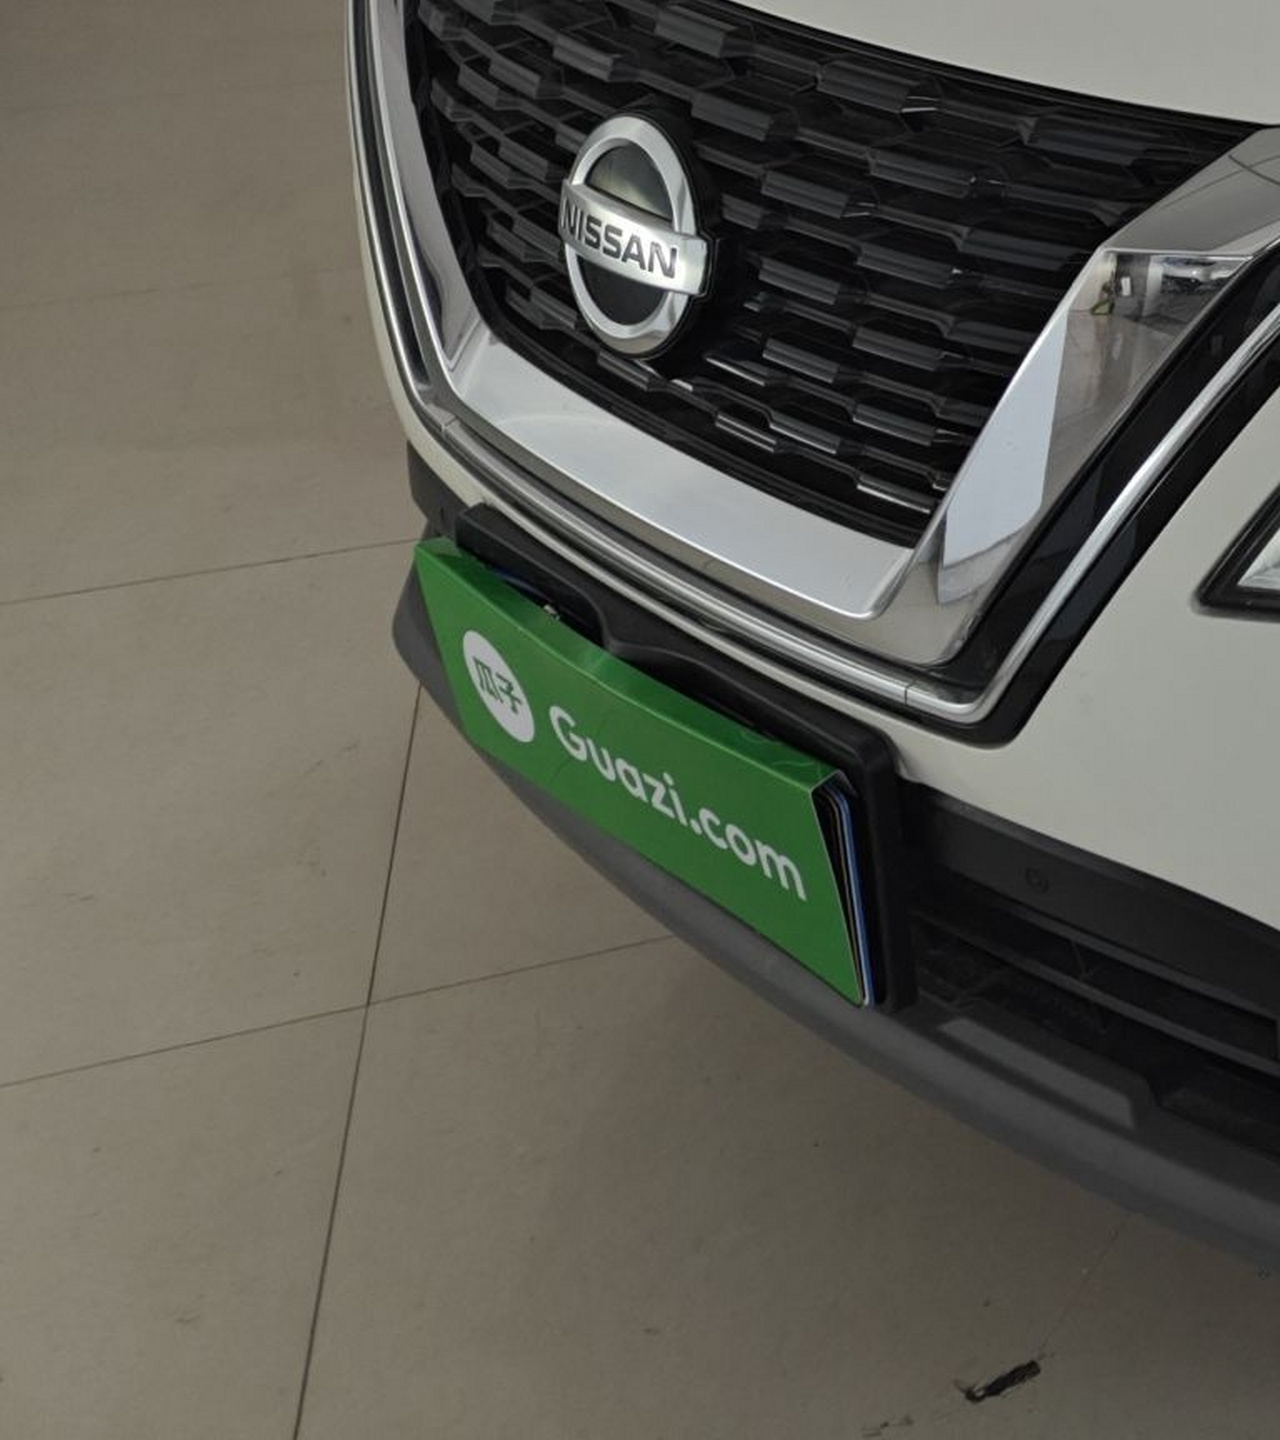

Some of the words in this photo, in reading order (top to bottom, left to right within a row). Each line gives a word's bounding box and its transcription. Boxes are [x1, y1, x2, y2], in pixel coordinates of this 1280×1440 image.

[560, 200, 679, 279] NISSAN
[472, 655, 523, 715] 瓜子
[548, 706, 808, 902] Guazi.com
